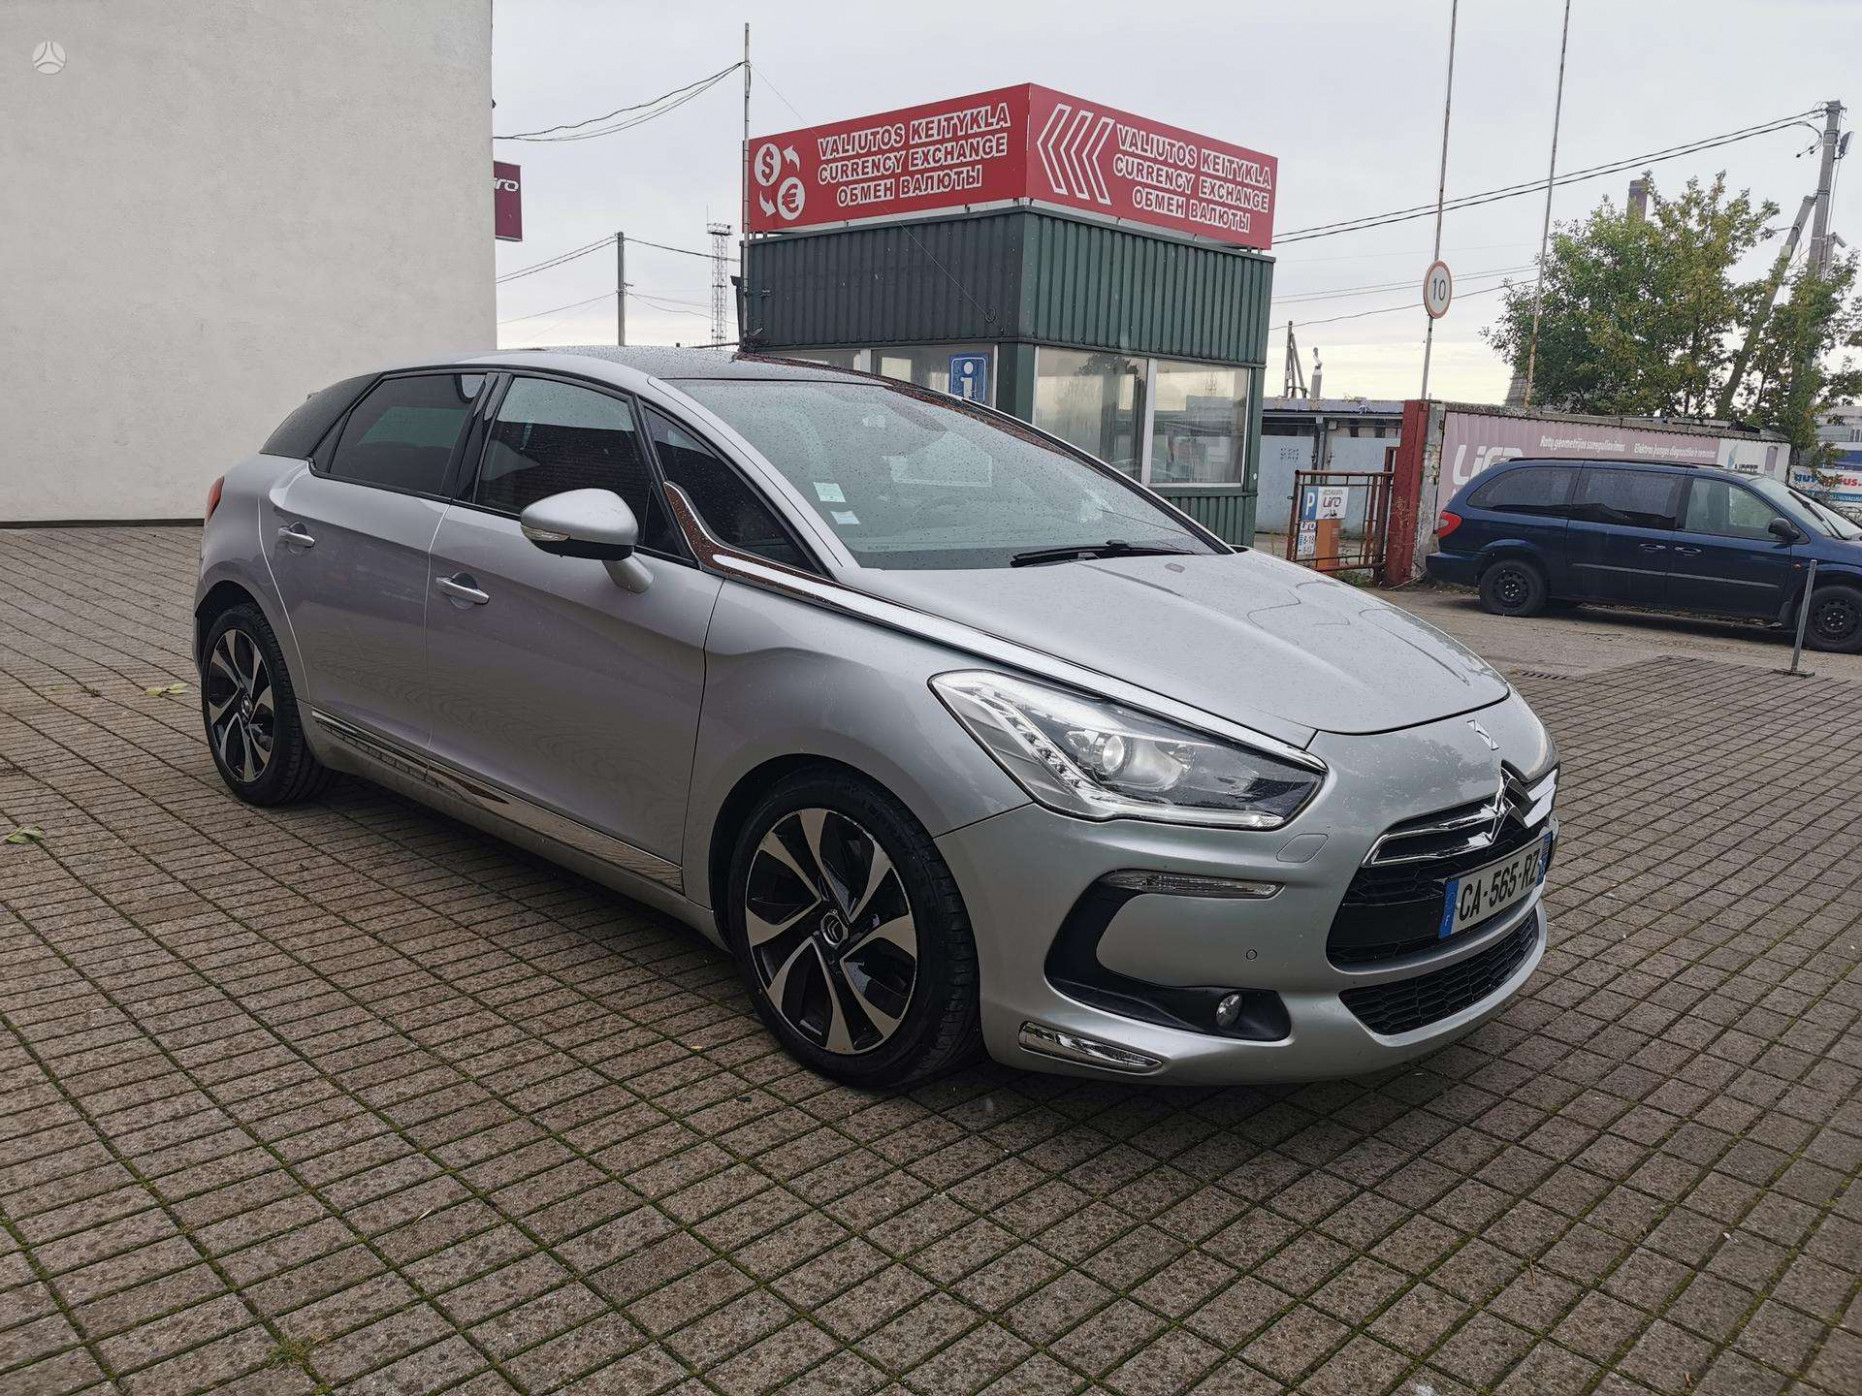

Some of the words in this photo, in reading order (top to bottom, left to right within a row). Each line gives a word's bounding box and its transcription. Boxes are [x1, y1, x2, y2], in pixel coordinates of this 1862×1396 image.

[818, 123, 905, 160] VALIUTOS
[910, 102, 1012, 144] KEITYKLA
[1116, 123, 1198, 168] VALIUTOS
[1201, 148, 1272, 189] KEITYKLA
[818, 152, 904, 185] CURRENCY
[908, 133, 1008, 171] EXCHANGE
[1113, 154, 1195, 194] CURRENCY
[1199, 176, 1269, 213] EXCHANGE
[837, 180, 895, 207] ОБМЕН
[900, 165, 983, 198] ВАЛЮТЫ
[1133, 186, 1186, 219] ОБМЕН
[1189, 199, 1251, 234] ВАЛЮТЫ
[1432, 277, 1447, 301] 10
[1305, 492, 1316, 516] P
[1459, 848, 1540, 921] CA-565-RZ
